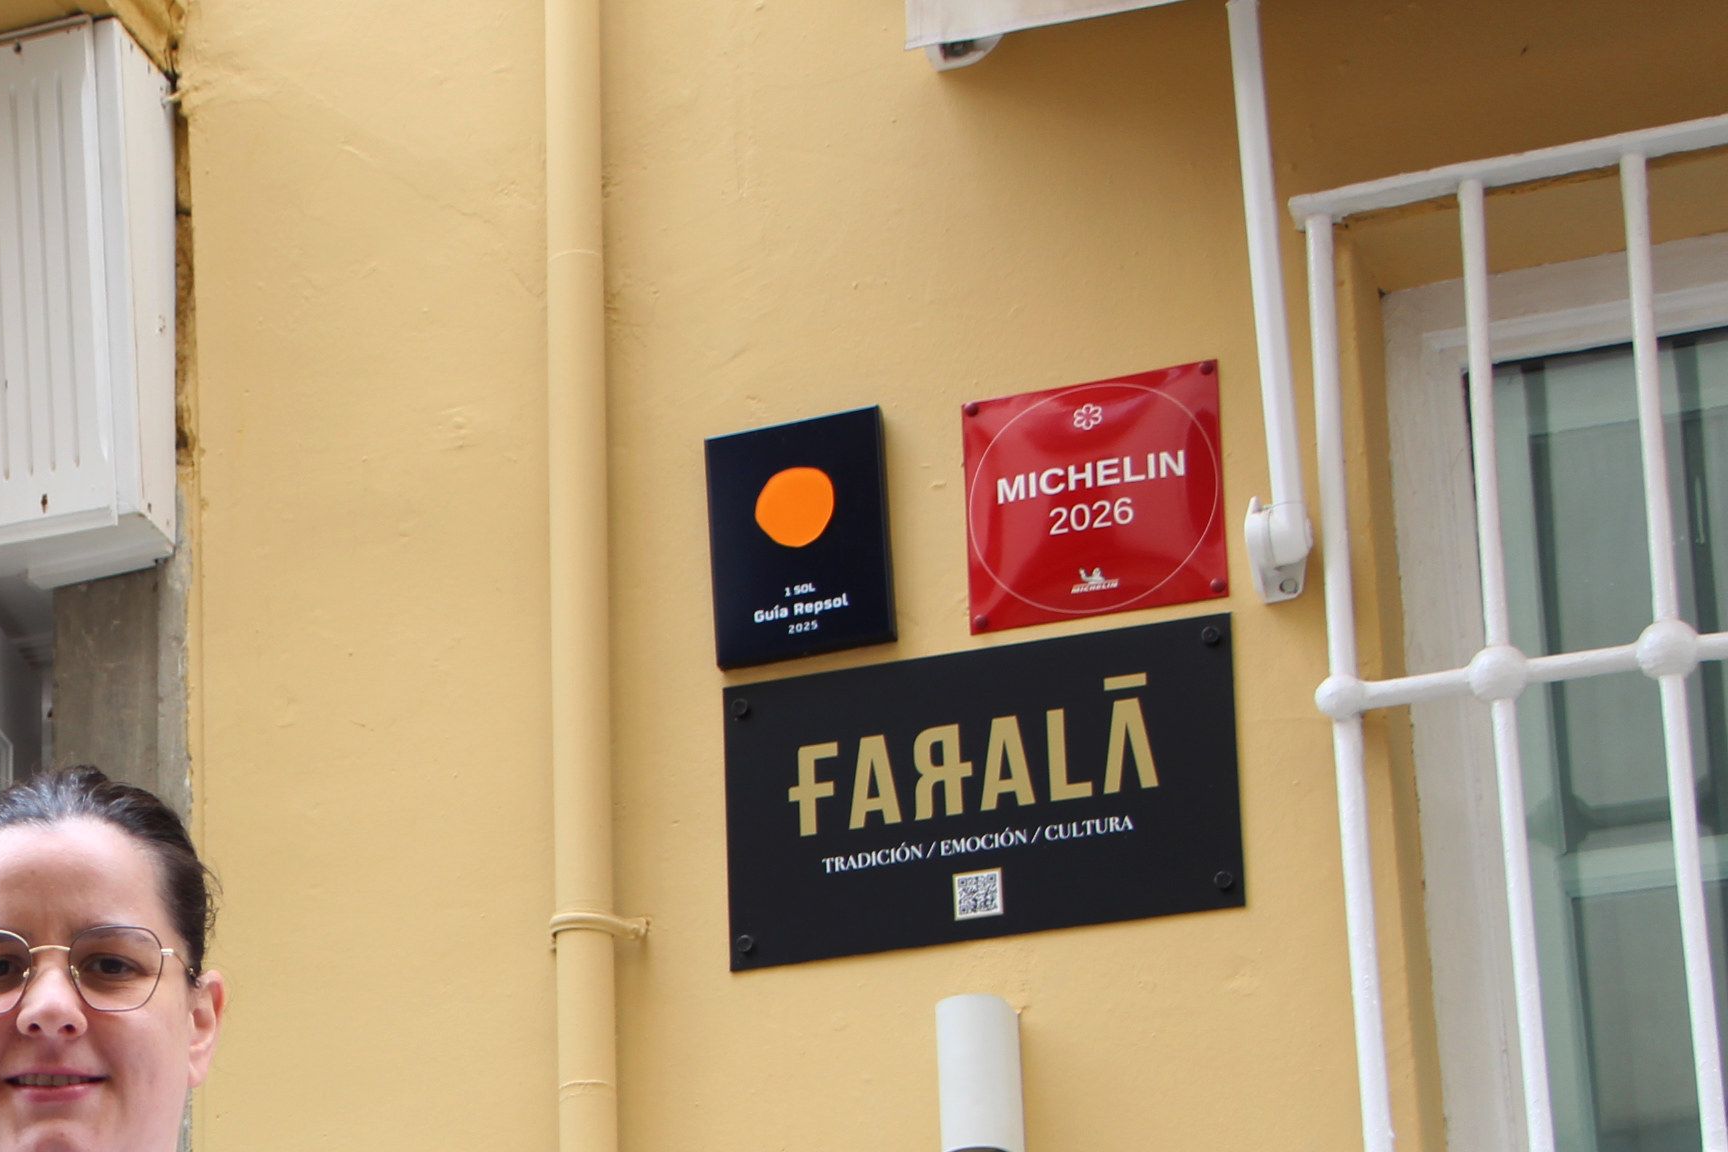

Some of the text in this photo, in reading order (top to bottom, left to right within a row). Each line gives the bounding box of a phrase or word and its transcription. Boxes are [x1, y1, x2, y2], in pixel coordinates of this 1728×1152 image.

[995, 449, 1186, 505] MICHELIN
[1049, 497, 1134, 536] 2026
[785, 583, 817, 598] 1 SOL
[754, 593, 849, 623] Guía Repsol
[788, 620, 819, 635] 2025
[822, 842, 923, 874] TRADICIÓN
[940, 827, 1028, 857] EMOCIÓN
[1044, 815, 1134, 841] CULTURA
